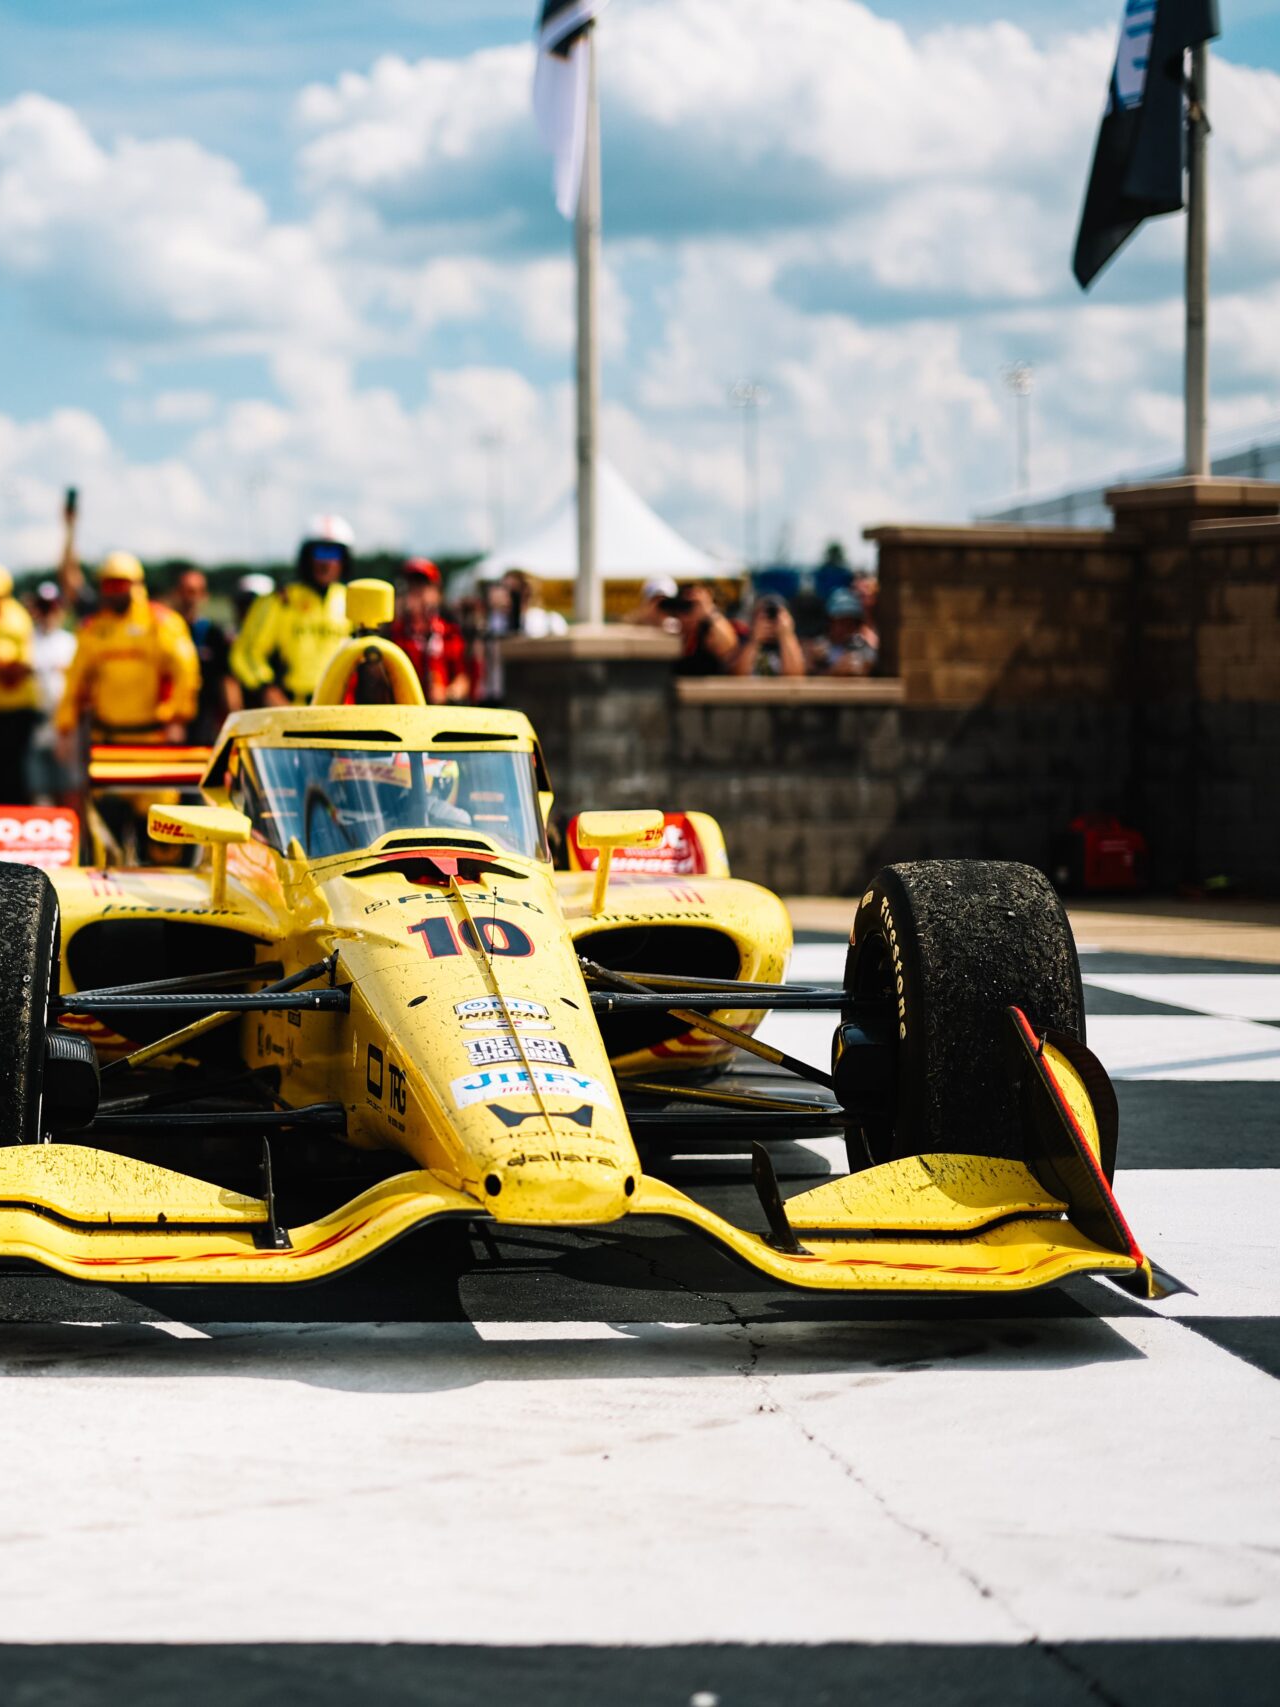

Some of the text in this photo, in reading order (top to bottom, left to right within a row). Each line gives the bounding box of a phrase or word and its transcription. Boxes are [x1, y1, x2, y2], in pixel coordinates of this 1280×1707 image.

[153, 820, 184, 837] DHL
[406, 916, 535, 960] 10
[880, 896, 907, 1040] Firestone
[458, 1010, 550, 1021] INDYCAR
[464, 1071, 591, 1090] JIFFY
[507, 1151, 617, 1170] dallara
